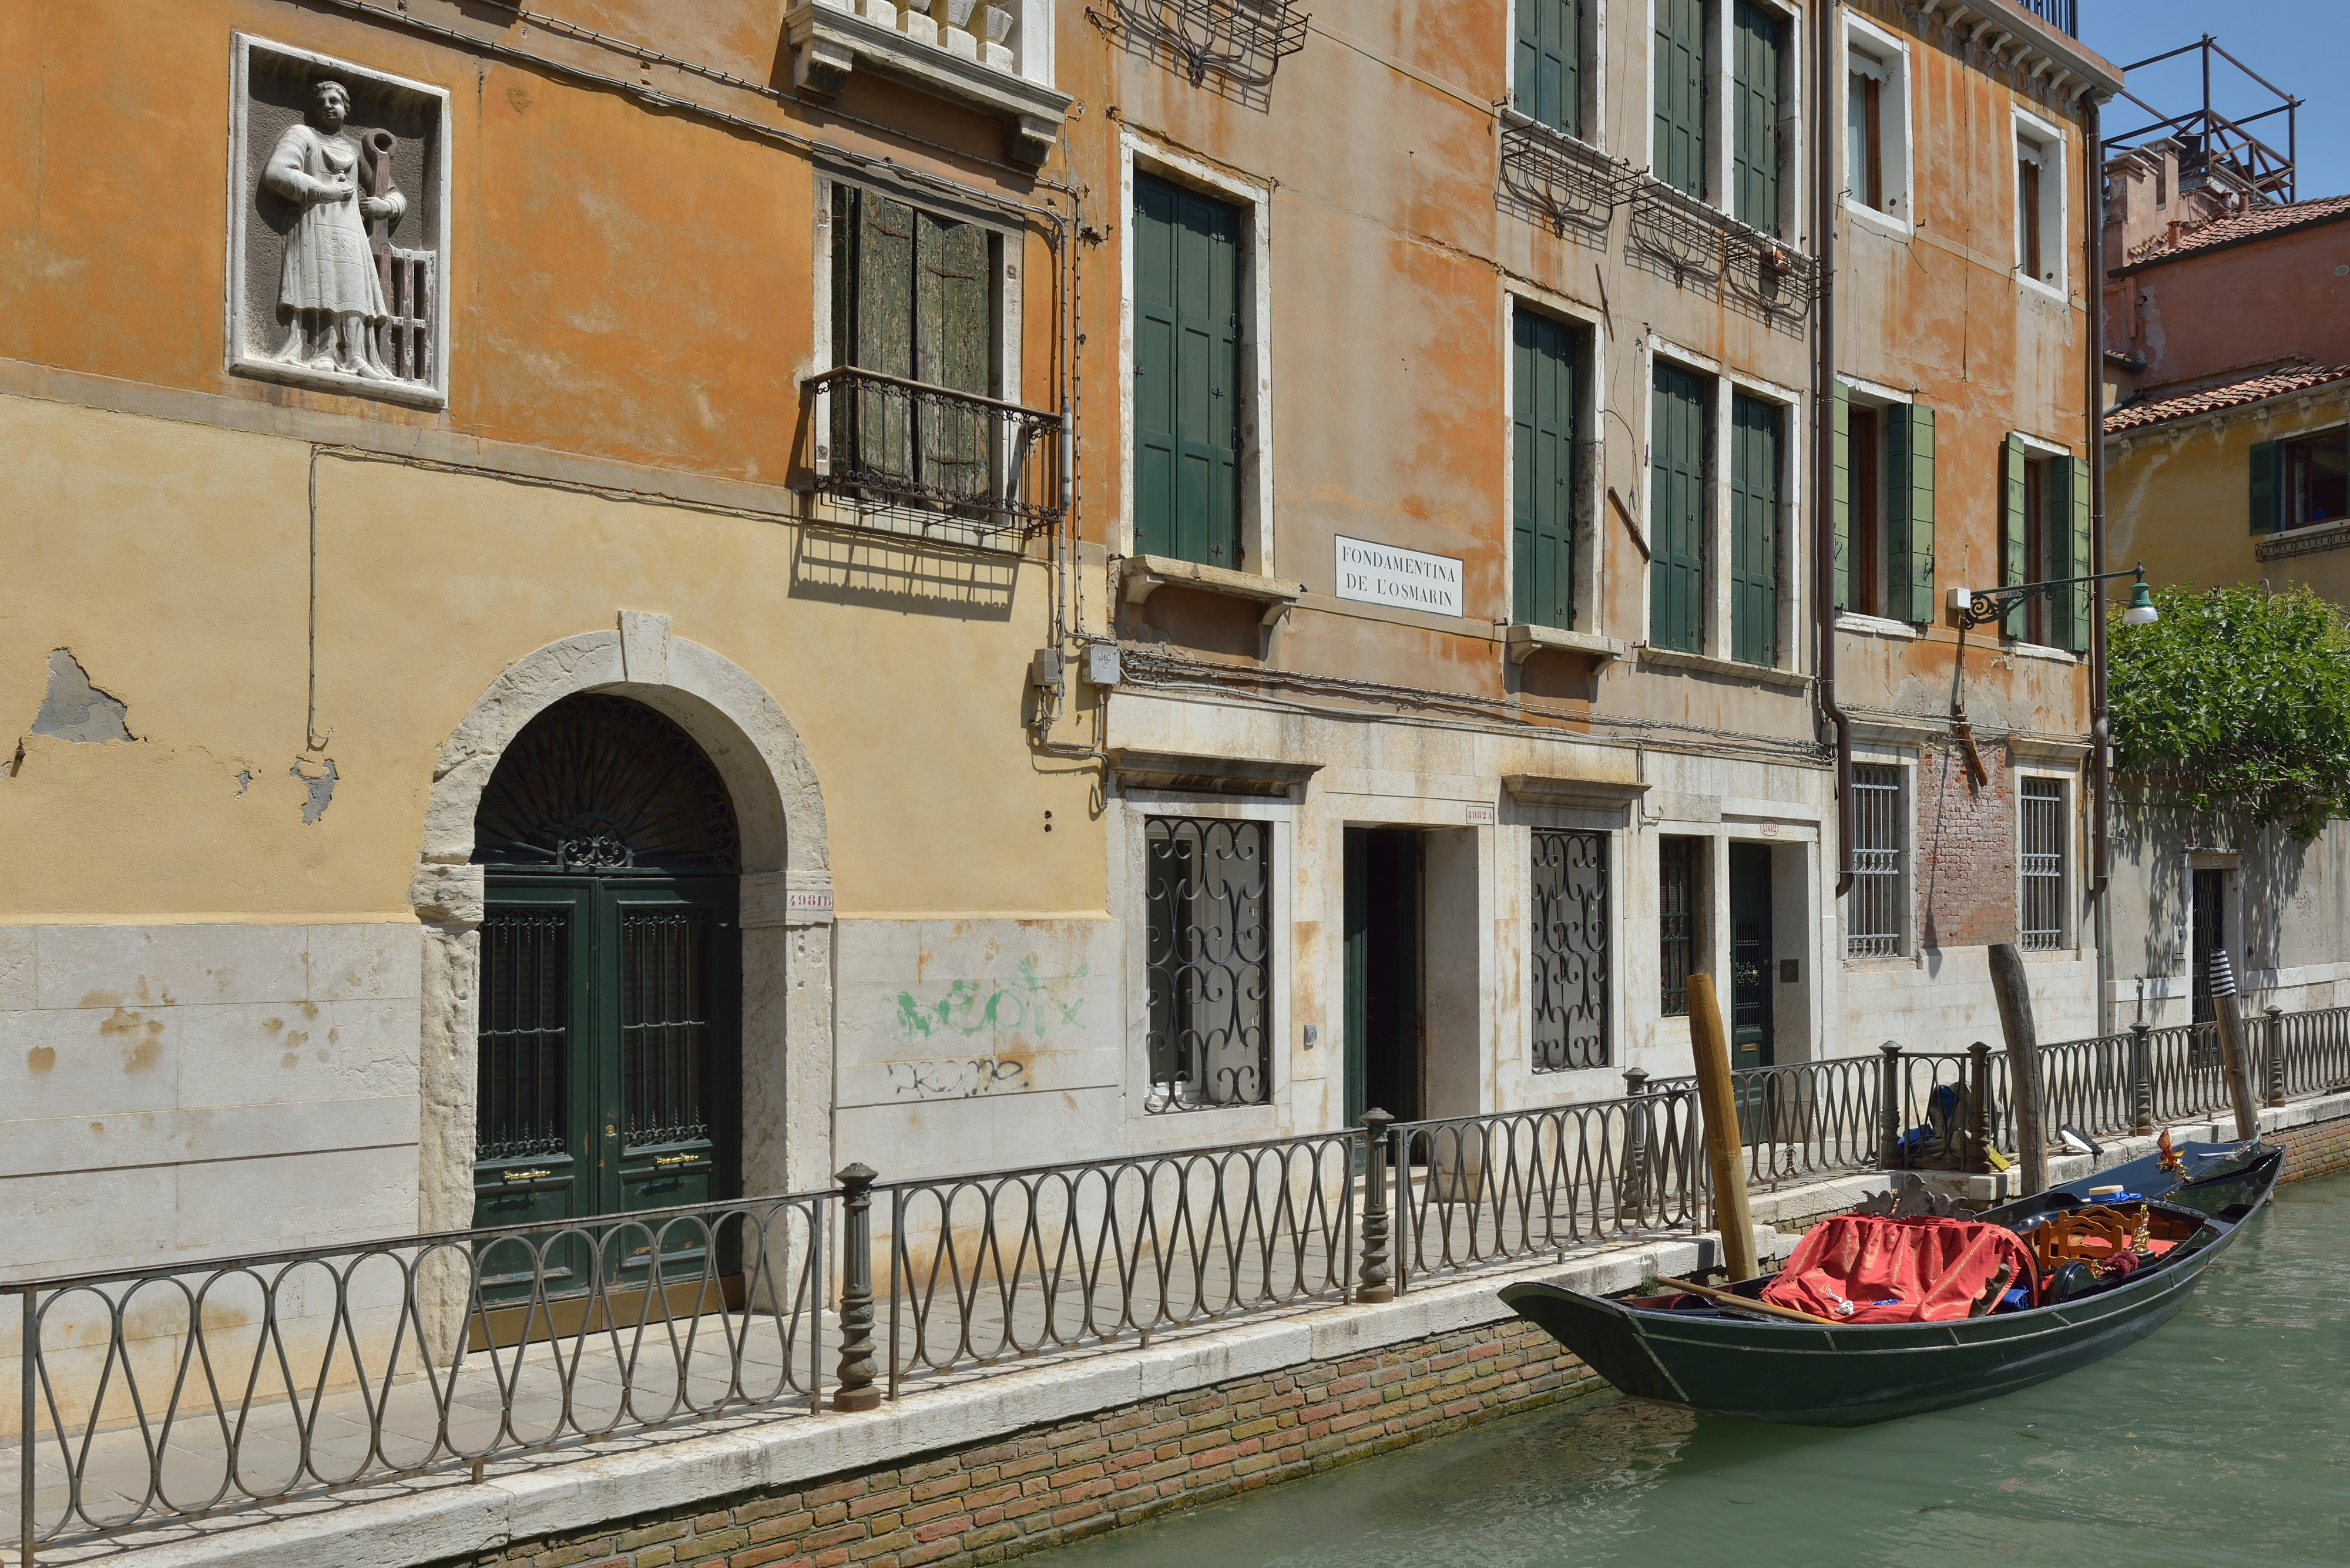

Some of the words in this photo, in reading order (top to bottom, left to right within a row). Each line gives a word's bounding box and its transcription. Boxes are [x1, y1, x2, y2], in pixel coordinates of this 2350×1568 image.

[1342, 545, 1456, 583] FONDAMENTINA
[1346, 573, 1368, 592] DE
[1377, 578, 1452, 607] L'OSMARIN
[1099, 653, 1112, 662] 380
[788, 894, 832, 906] 4981B
